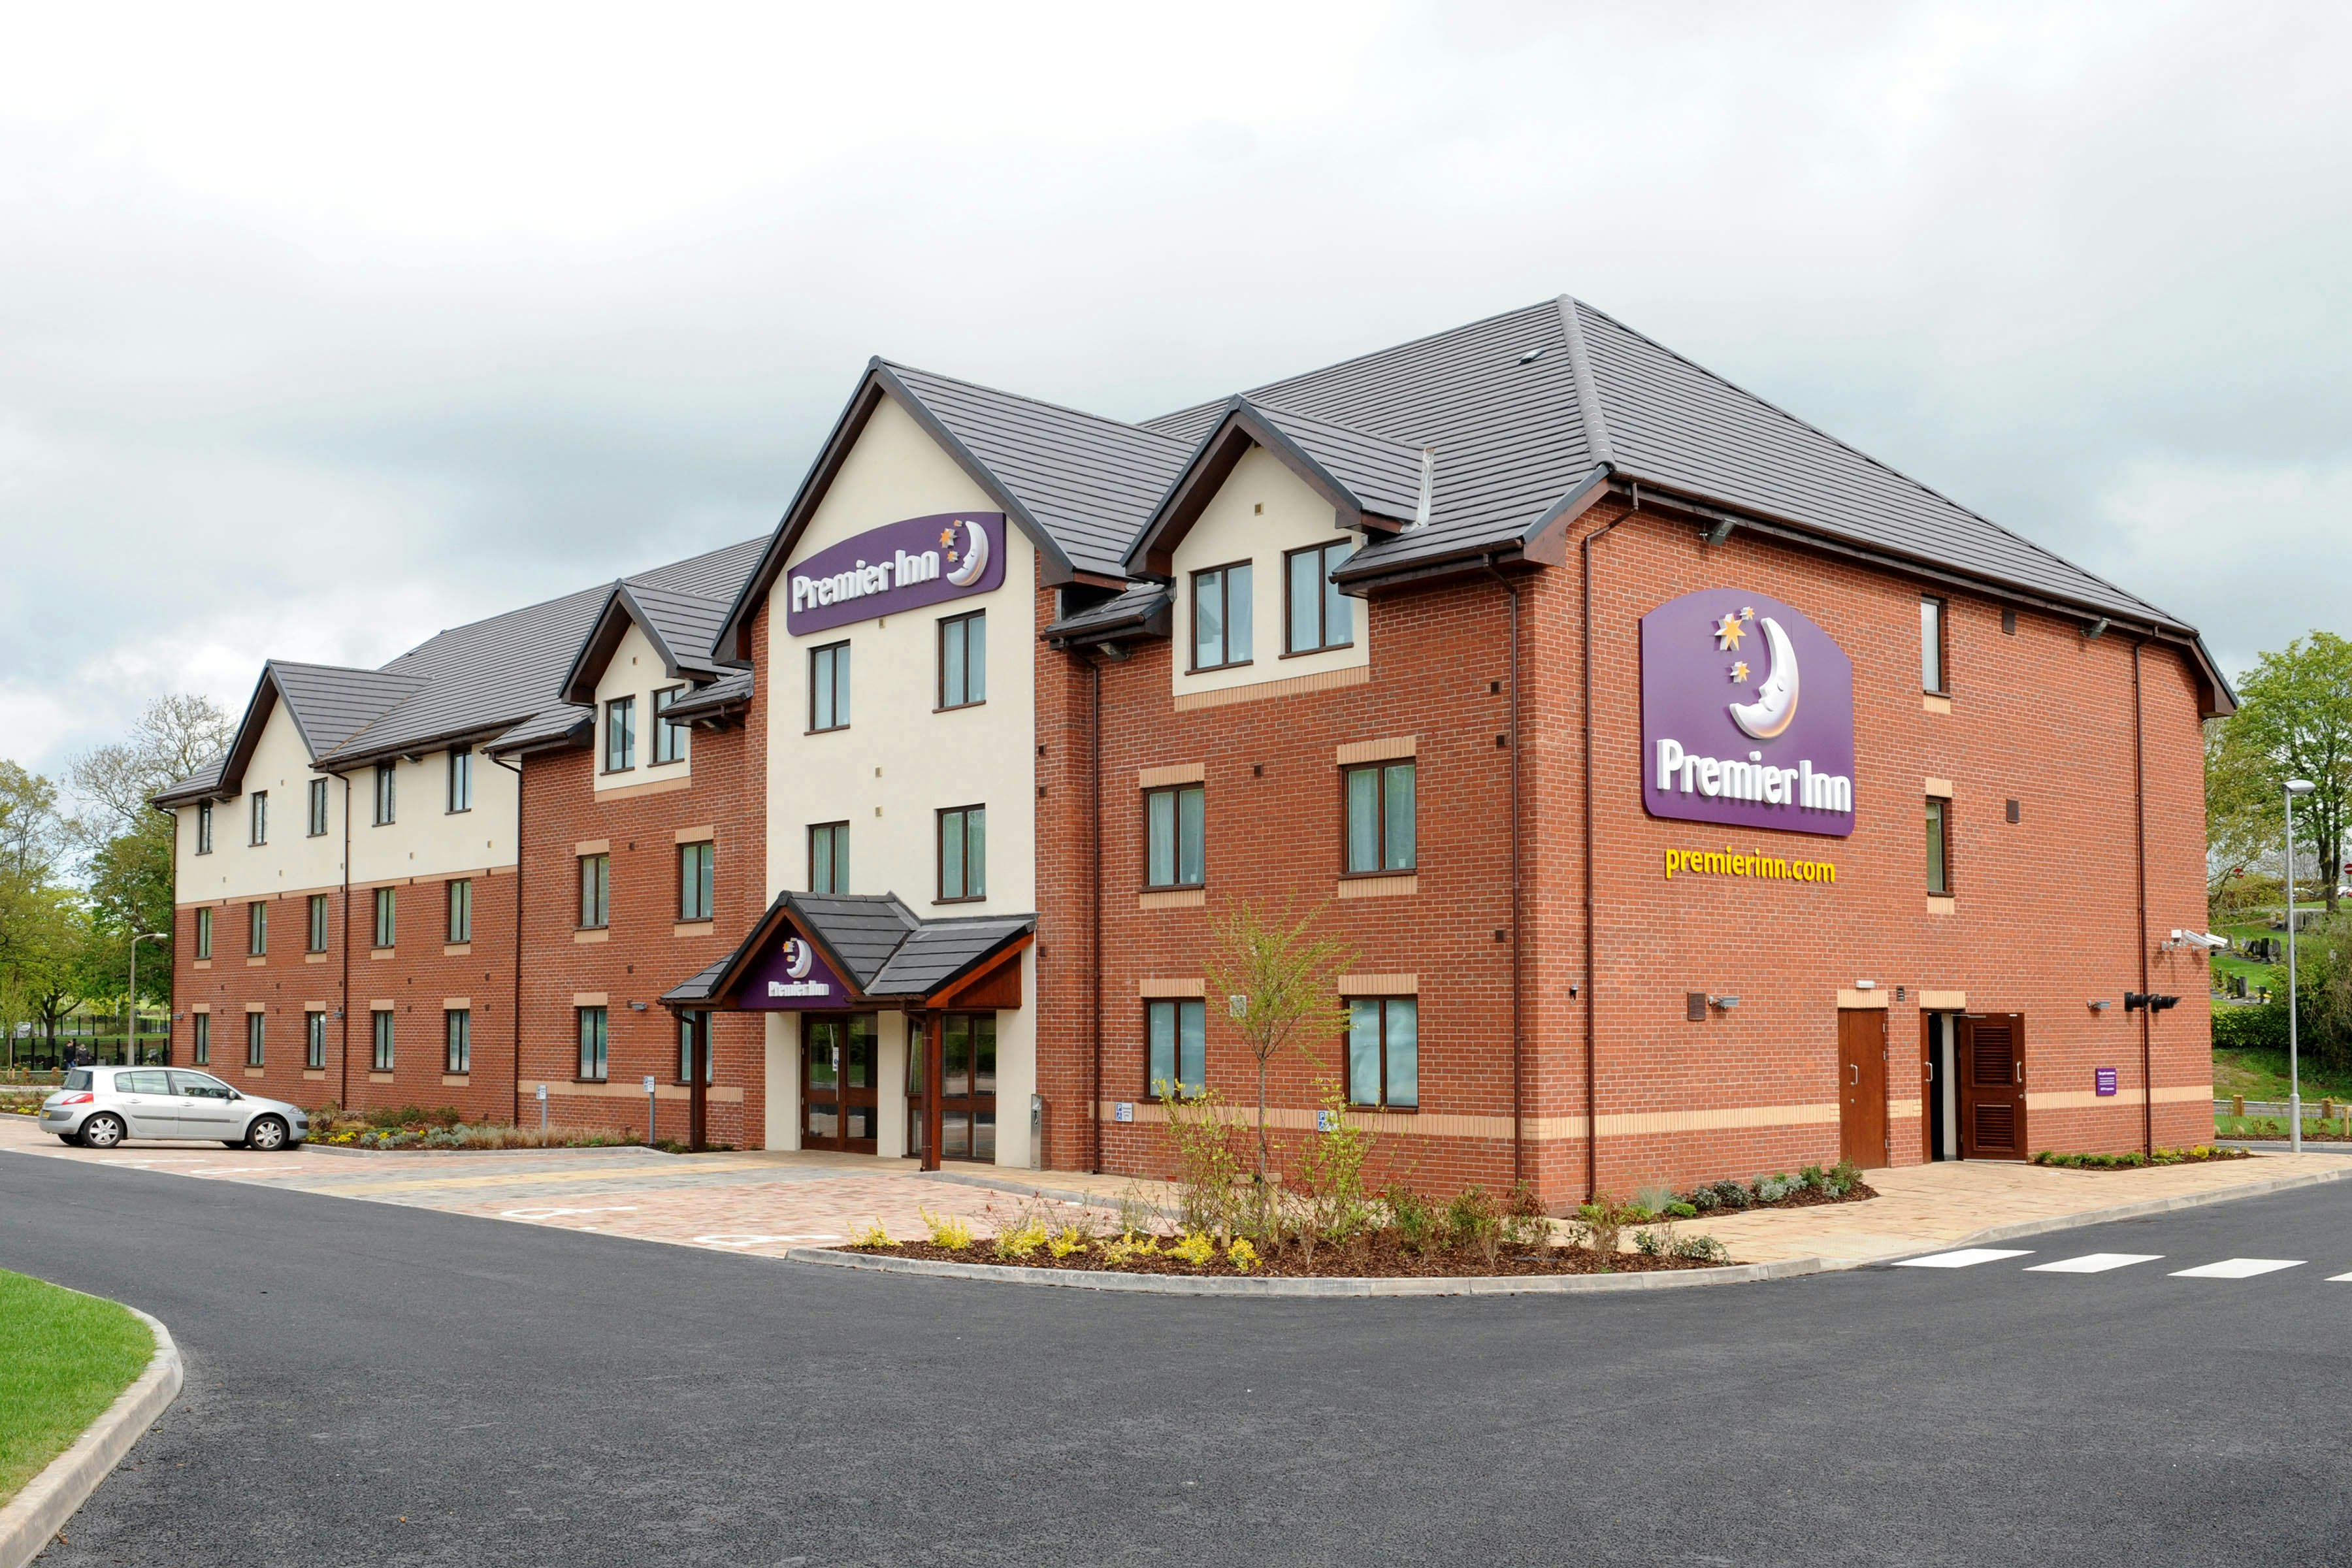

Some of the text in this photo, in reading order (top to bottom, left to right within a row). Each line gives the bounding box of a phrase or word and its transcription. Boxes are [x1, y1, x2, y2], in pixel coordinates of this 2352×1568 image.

[792, 549, 939, 613] Premier Inn
[1657, 739, 1852, 812] Premier Inn
[1666, 845, 1836, 883] premierinn.com
[768, 980, 829, 996] Premier Inn
